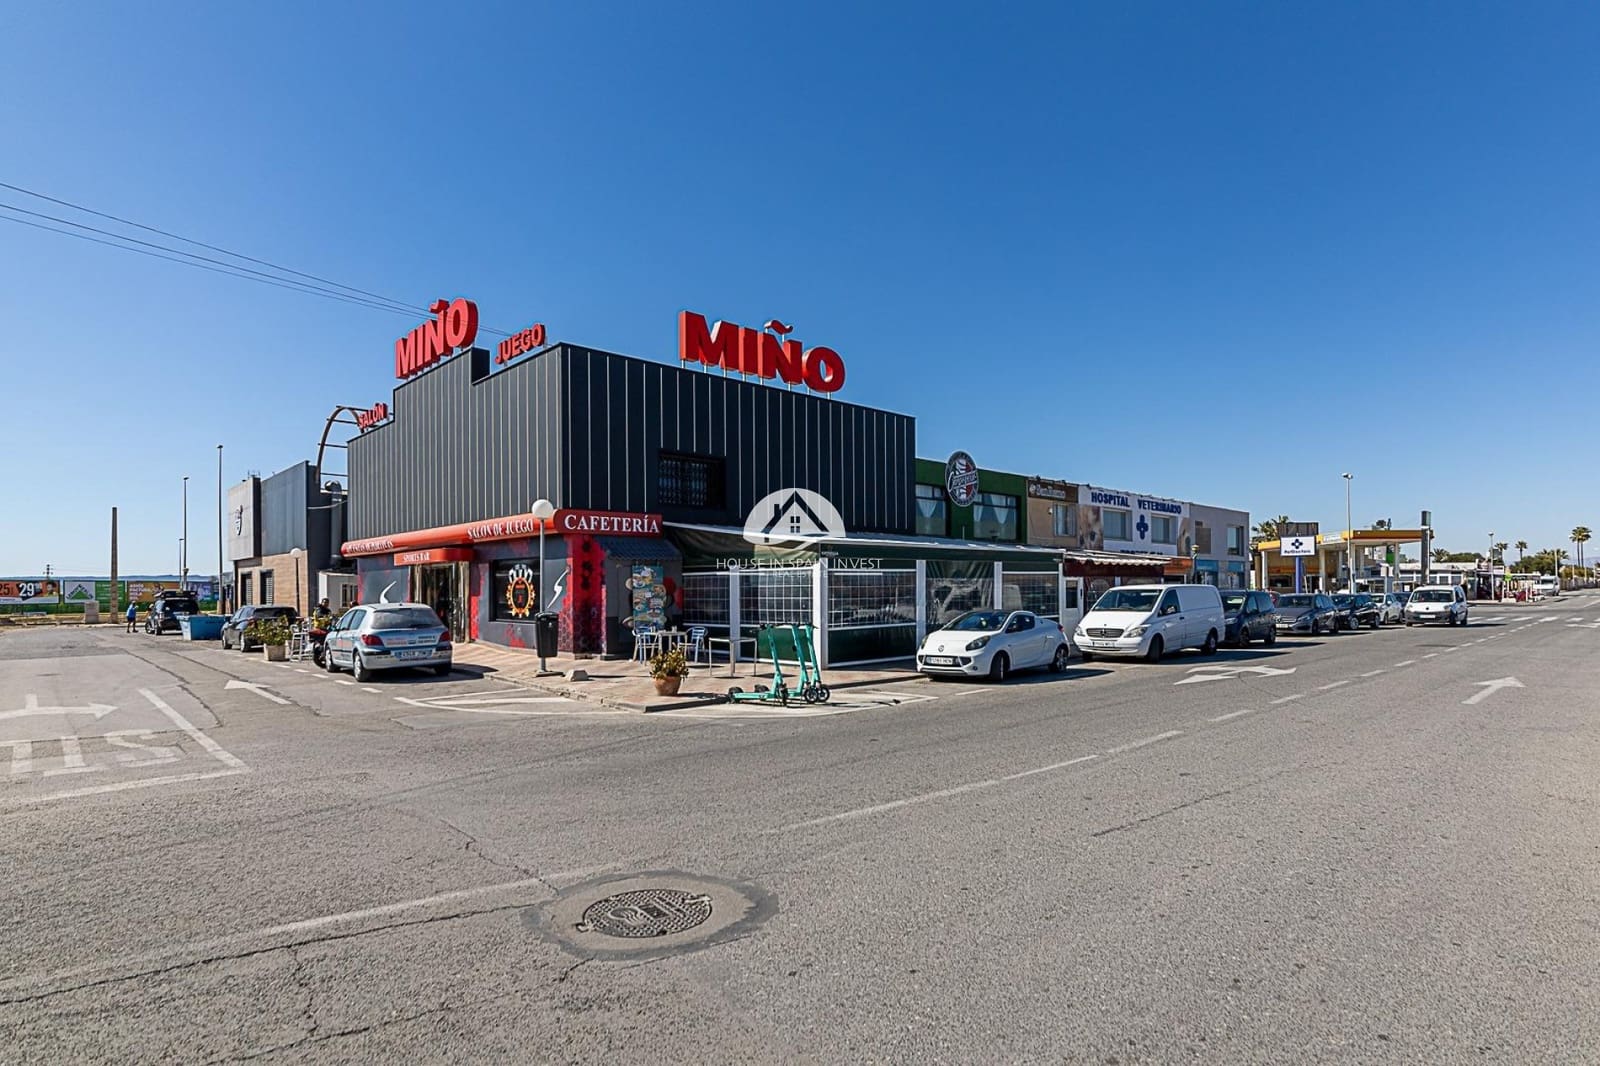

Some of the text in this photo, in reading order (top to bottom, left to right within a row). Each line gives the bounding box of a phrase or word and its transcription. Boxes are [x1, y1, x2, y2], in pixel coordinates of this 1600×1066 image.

[395, 298, 478, 379] MIÑO
[495, 323, 546, 364] JUEGO
[679, 310, 846, 393] MIÑO
[358, 403, 388, 428] SALÓN
[1091, 491, 1182, 515] HOSPITAL VETERINARIO
[493, 523, 503, 537] DE
[505, 518, 534, 536] JUEGO
[564, 514, 660, 533] CAFETERÍA
[19, 583, 34, 597] 29
